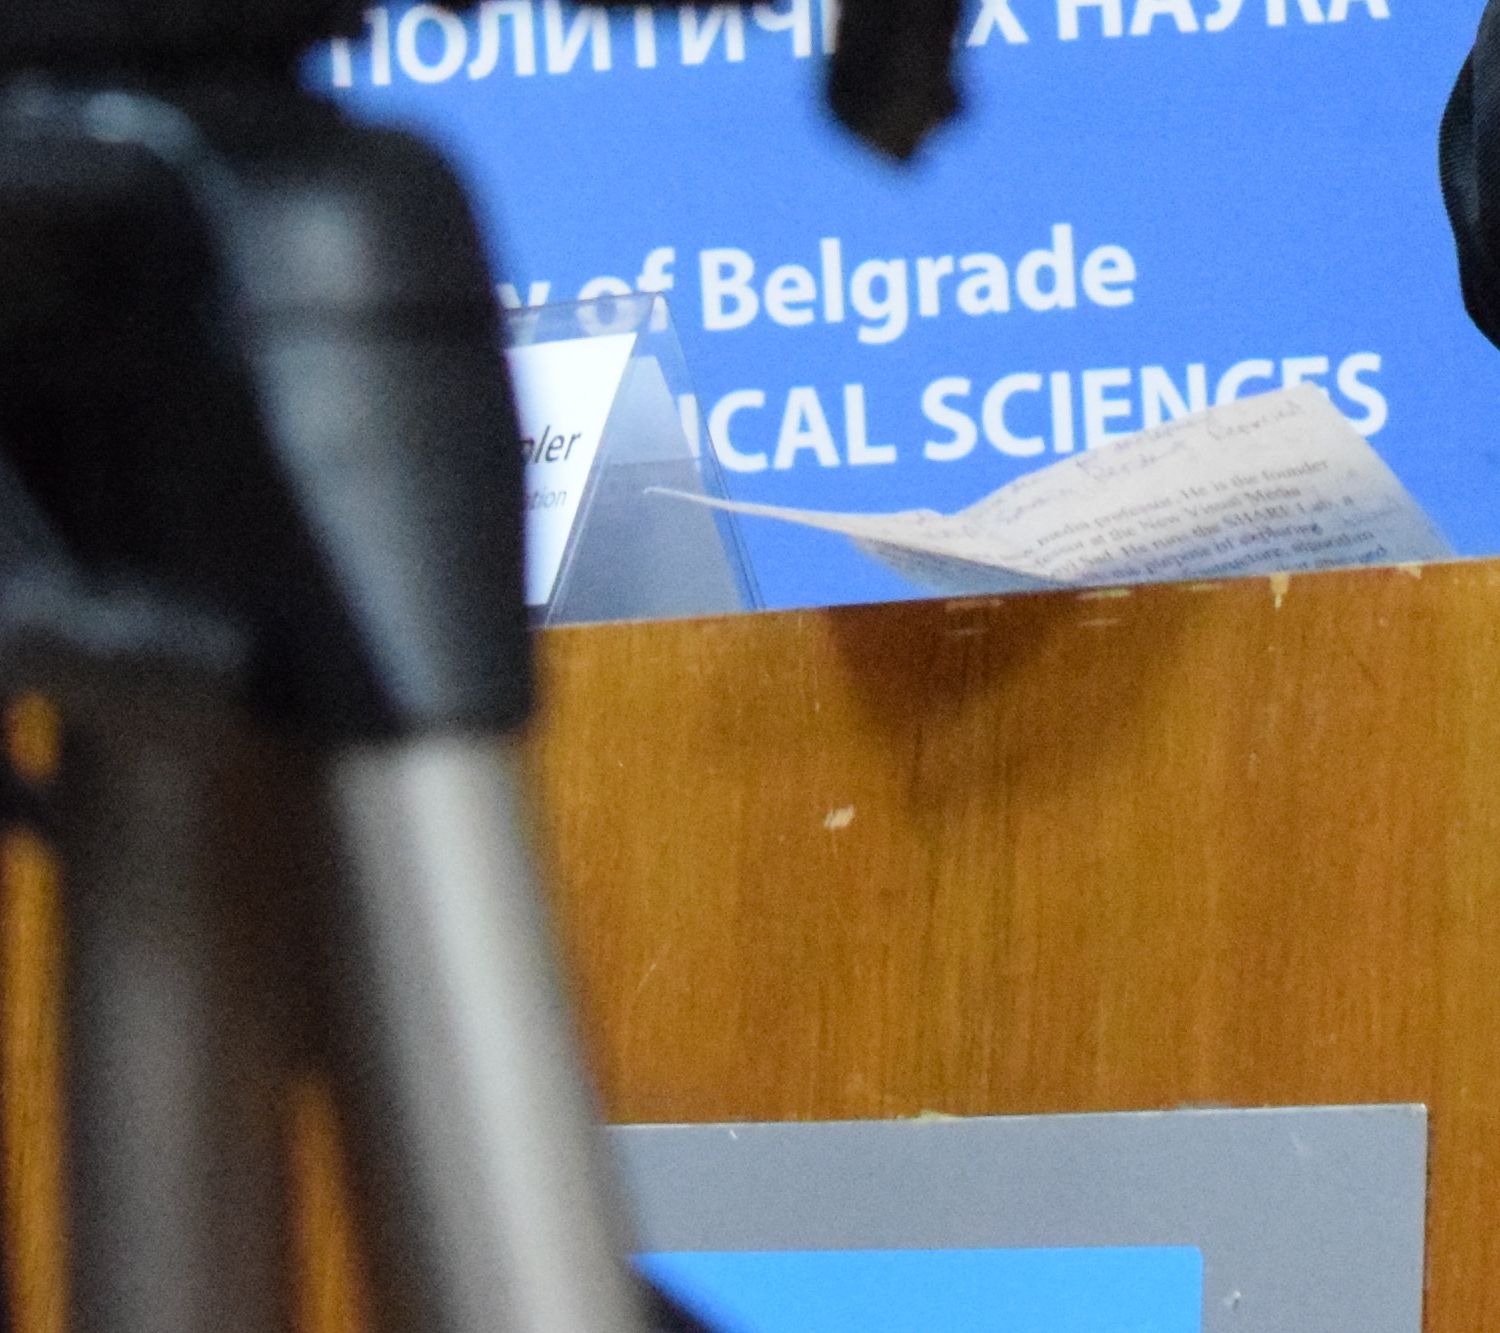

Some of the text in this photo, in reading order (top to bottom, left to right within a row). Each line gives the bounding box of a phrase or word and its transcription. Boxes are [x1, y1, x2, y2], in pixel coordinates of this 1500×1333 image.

[576, 247, 676, 336] of
[700, 223, 1136, 344] Belgrade
[1179, 484, 1208, 501] He
[1214, 480, 1229, 492] is
[1230, 474, 1258, 487] the
[1262, 459, 1329, 483] founder
[1108, 525, 1138, 541] the
[1182, 495, 1243, 519] Visual
[1243, 484, 1301, 504] Media
[1152, 533, 1189, 550] runs
[1190, 523, 1221, 537] the
[1222, 503, 1290, 528] SHARE
[1144, 545, 1211, 574] purpose
